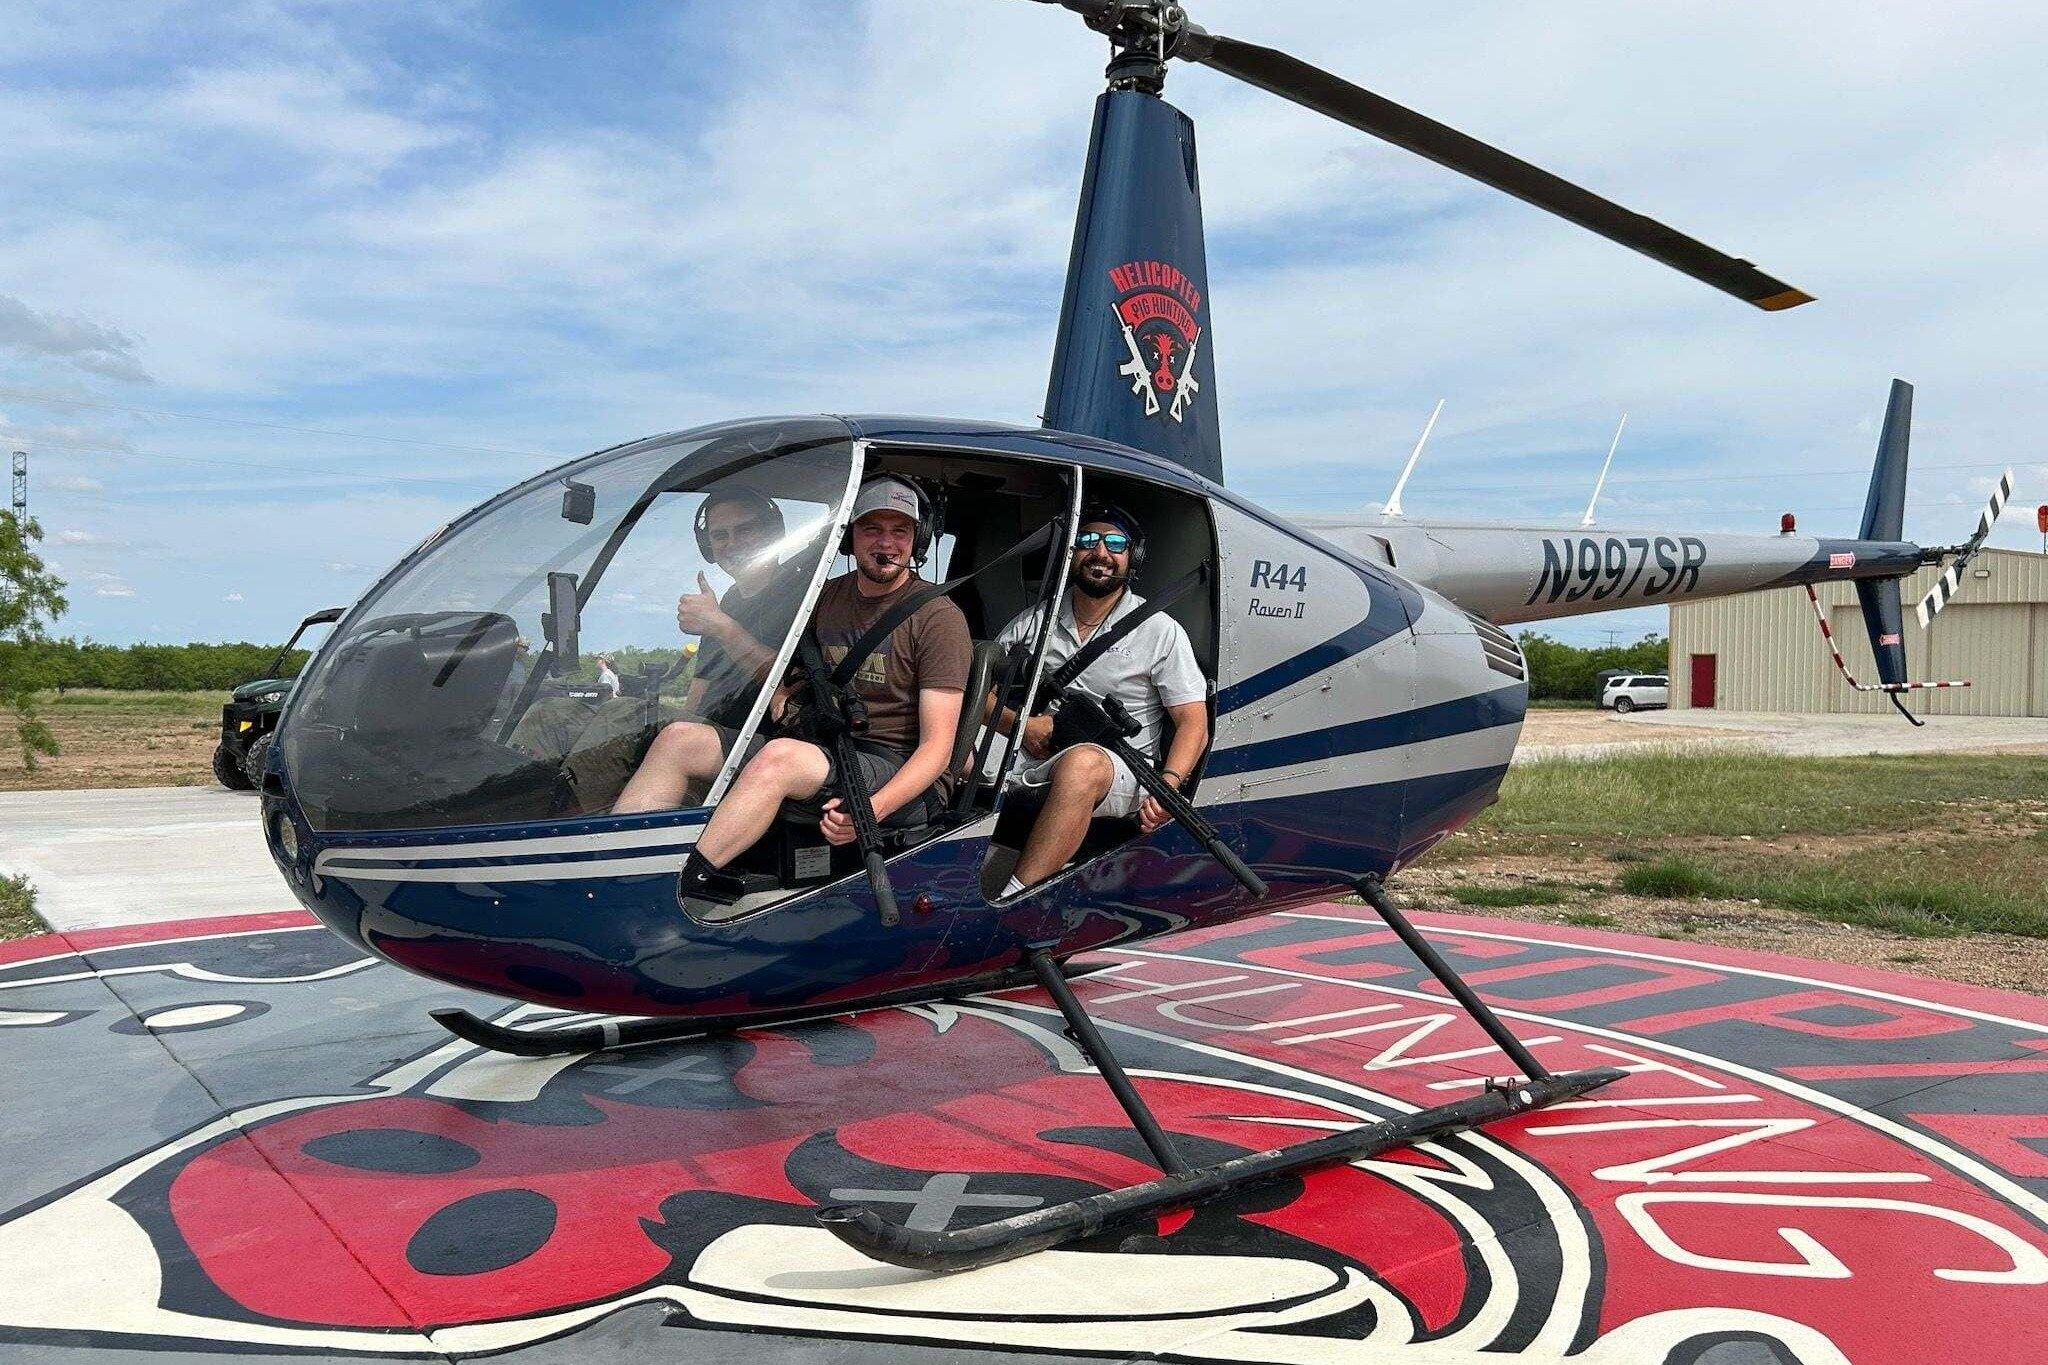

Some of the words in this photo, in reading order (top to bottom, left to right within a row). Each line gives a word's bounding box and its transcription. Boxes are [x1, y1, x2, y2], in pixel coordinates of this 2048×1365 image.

[1109, 261, 1201, 312] HELICOPTER
[1131, 298, 1150, 319] PIG
[1152, 297, 1191, 333] HUNTING
[1250, 559, 1307, 592] R44
[1525, 536, 1707, 606] N997SR
[1248, 598, 1292, 618] Raven
[1294, 602, 1305, 618] II
